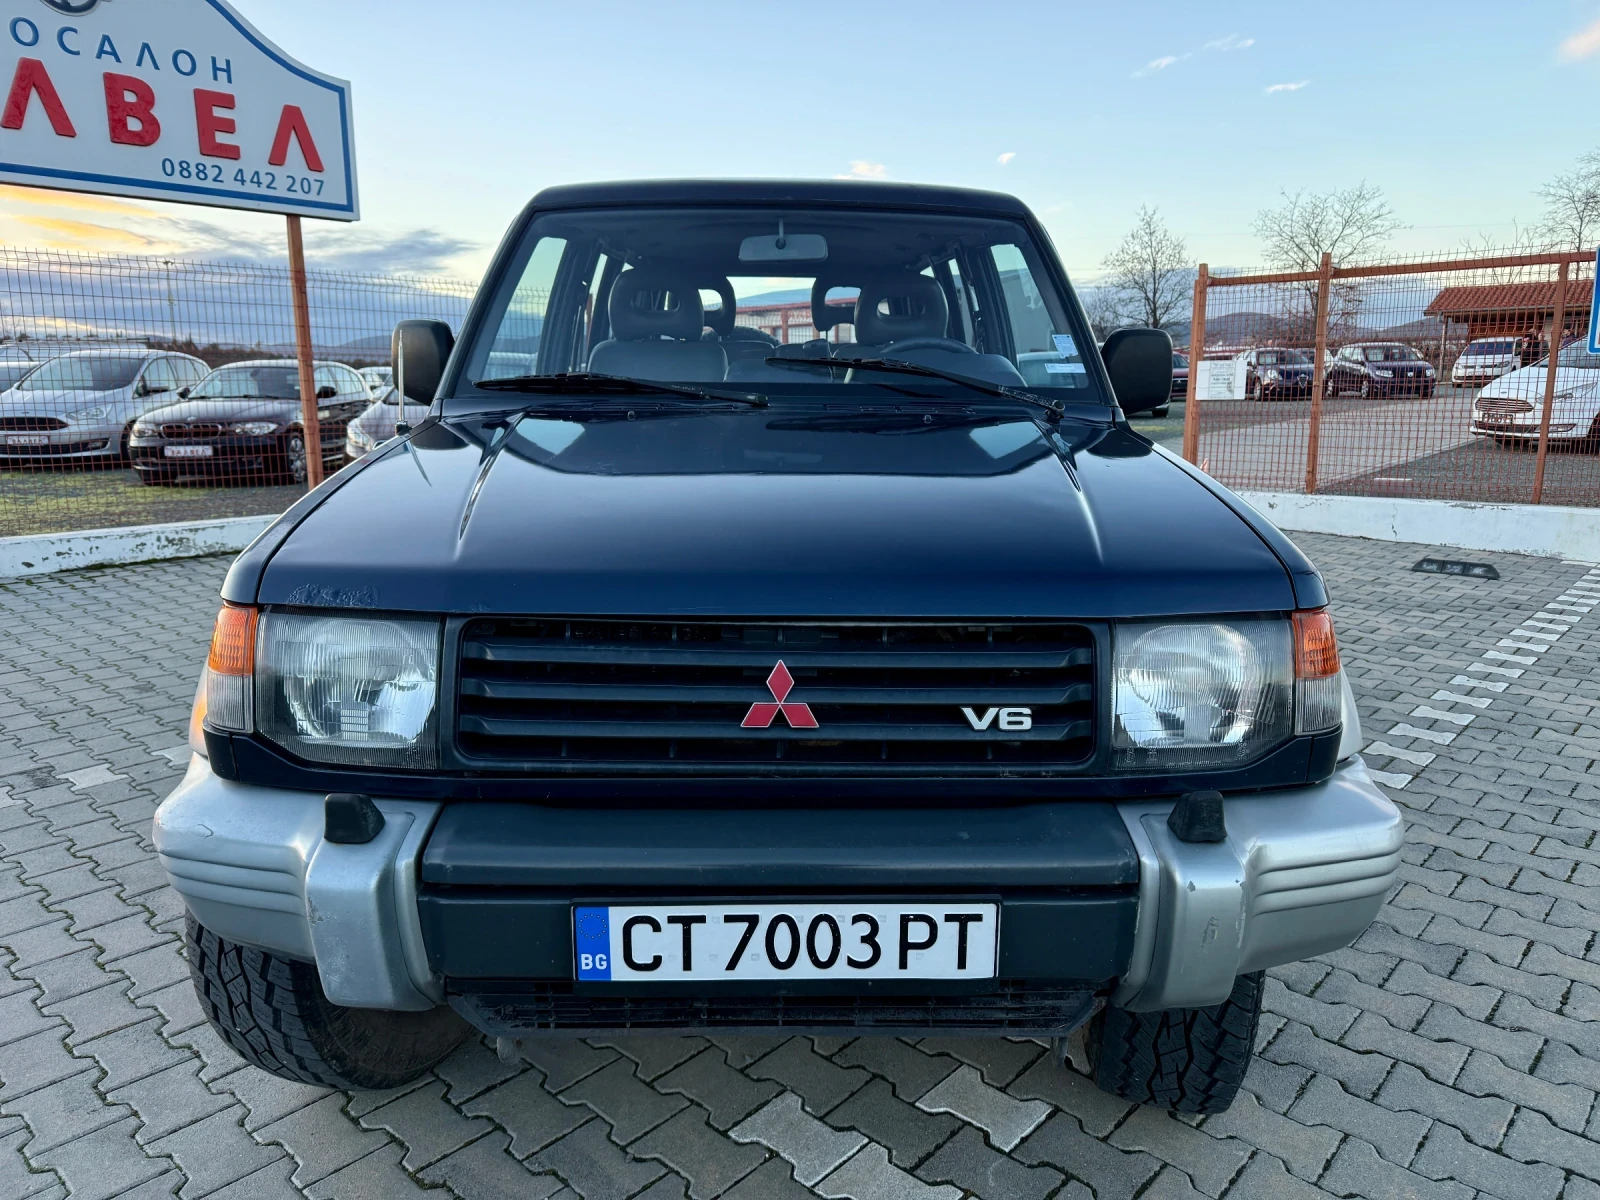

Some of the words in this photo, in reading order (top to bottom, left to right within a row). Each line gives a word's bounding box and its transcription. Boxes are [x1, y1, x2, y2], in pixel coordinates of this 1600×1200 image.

[9, 16, 233, 84] ОСАЛОН
[161, 157, 225, 183] 0882
[233, 171, 278, 190] 442
[286, 175, 325, 196] 207
[960, 706, 1032, 730] V6
[581, 953, 608, 970] BG
[622, 914, 707, 972] CT
[723, 913, 882, 970] 7003
[898, 913, 984, 970] PT
